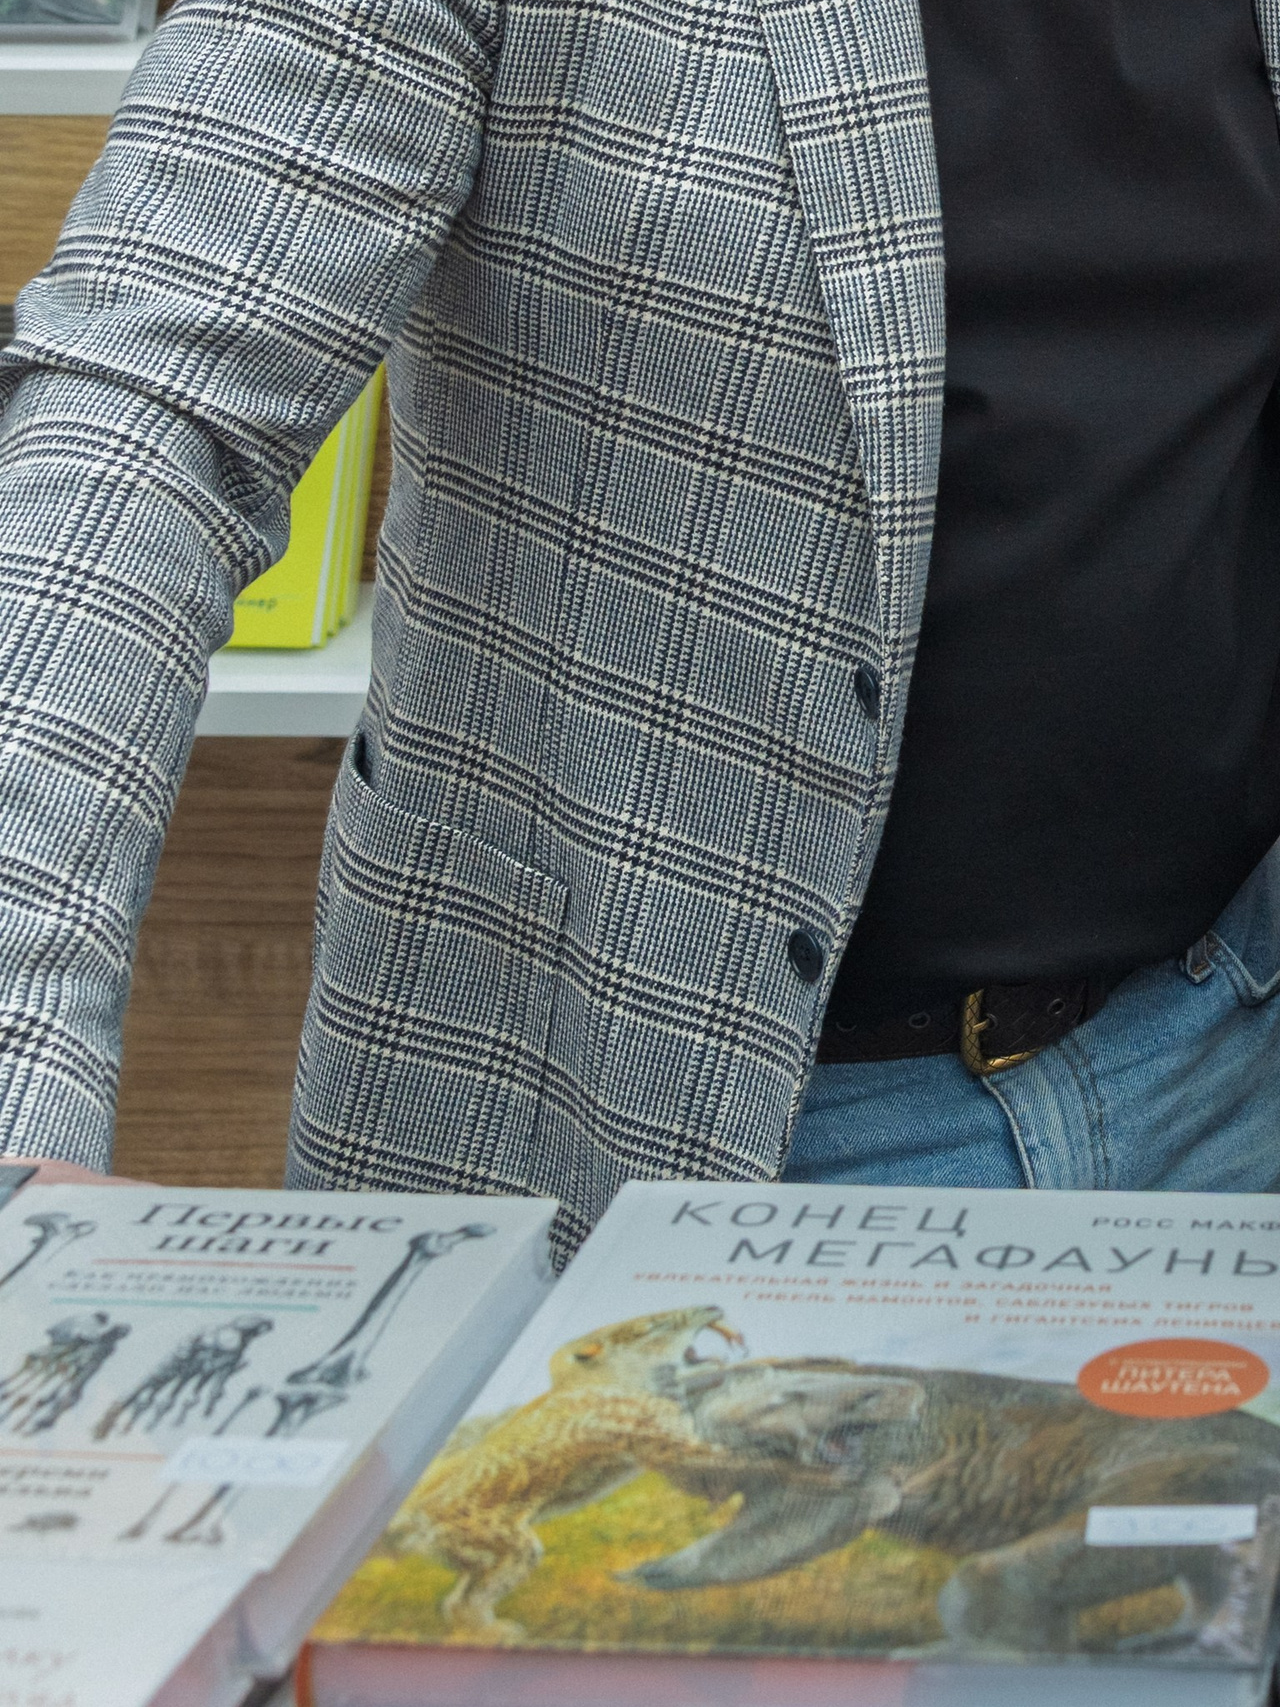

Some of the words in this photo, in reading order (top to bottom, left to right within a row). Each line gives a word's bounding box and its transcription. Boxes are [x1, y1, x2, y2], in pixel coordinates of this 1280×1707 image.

[131, 1202, 404, 1234] Первые
[671, 1200, 972, 1238] КОНЕЦ
[1092, 1216, 1174, 1230] РОСС
[152, 1234, 337, 1256] шаги
[632, 1272, 829, 1286] УВЛЕКАТЕЛЬНАЯ
[841, 1277, 923, 1290] ЖИЗНЬ
[934, 1279, 950, 1290] И
[959, 1280, 1114, 1293] ЗАГАДОЧНАЯ
[743, 1290, 835, 1304] ГИБЕЛЬ
[846, 1292, 982, 1308] МАМОНТОВ,
[995, 1297, 1152, 1311] САБЛЕЗУБЫХ
[1163, 1300, 1255, 1314] ТИГРОВ
[964, 1313, 980, 1324] И
[989, 1314, 1143, 1328] ГИГАНТСКИХ
[1118, 1366, 1233, 1382] ПИТЕРА
[1099, 1378, 1243, 1396] ШАУТЕНА
